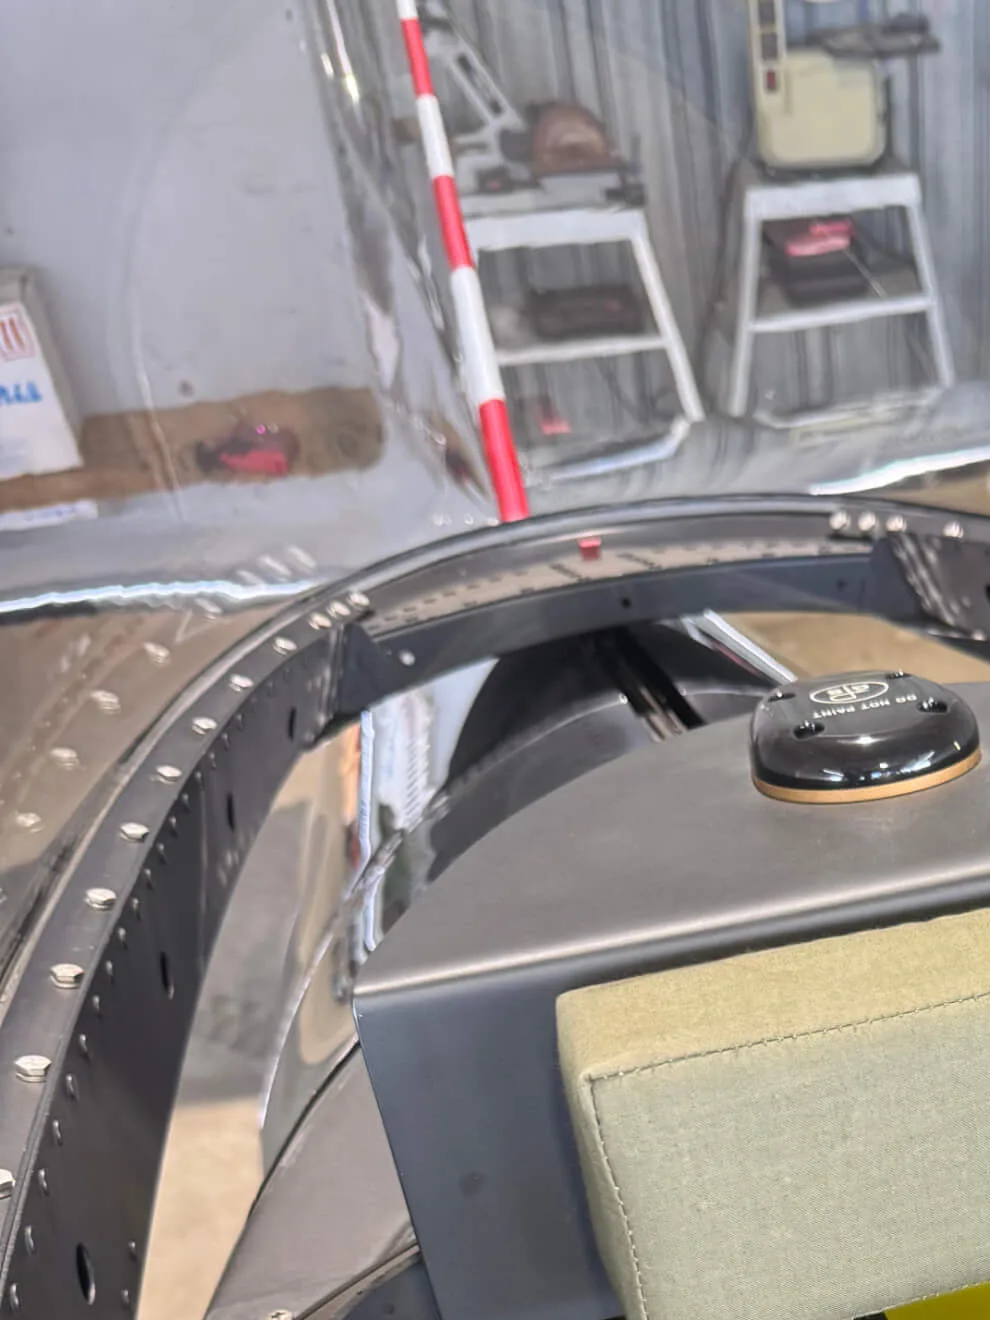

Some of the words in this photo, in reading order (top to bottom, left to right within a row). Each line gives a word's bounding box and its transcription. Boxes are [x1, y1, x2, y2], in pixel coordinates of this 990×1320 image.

[895, 694, 917, 703] DO
[861, 699, 890, 710] NOT
[813, 705, 856, 719] PAINT
